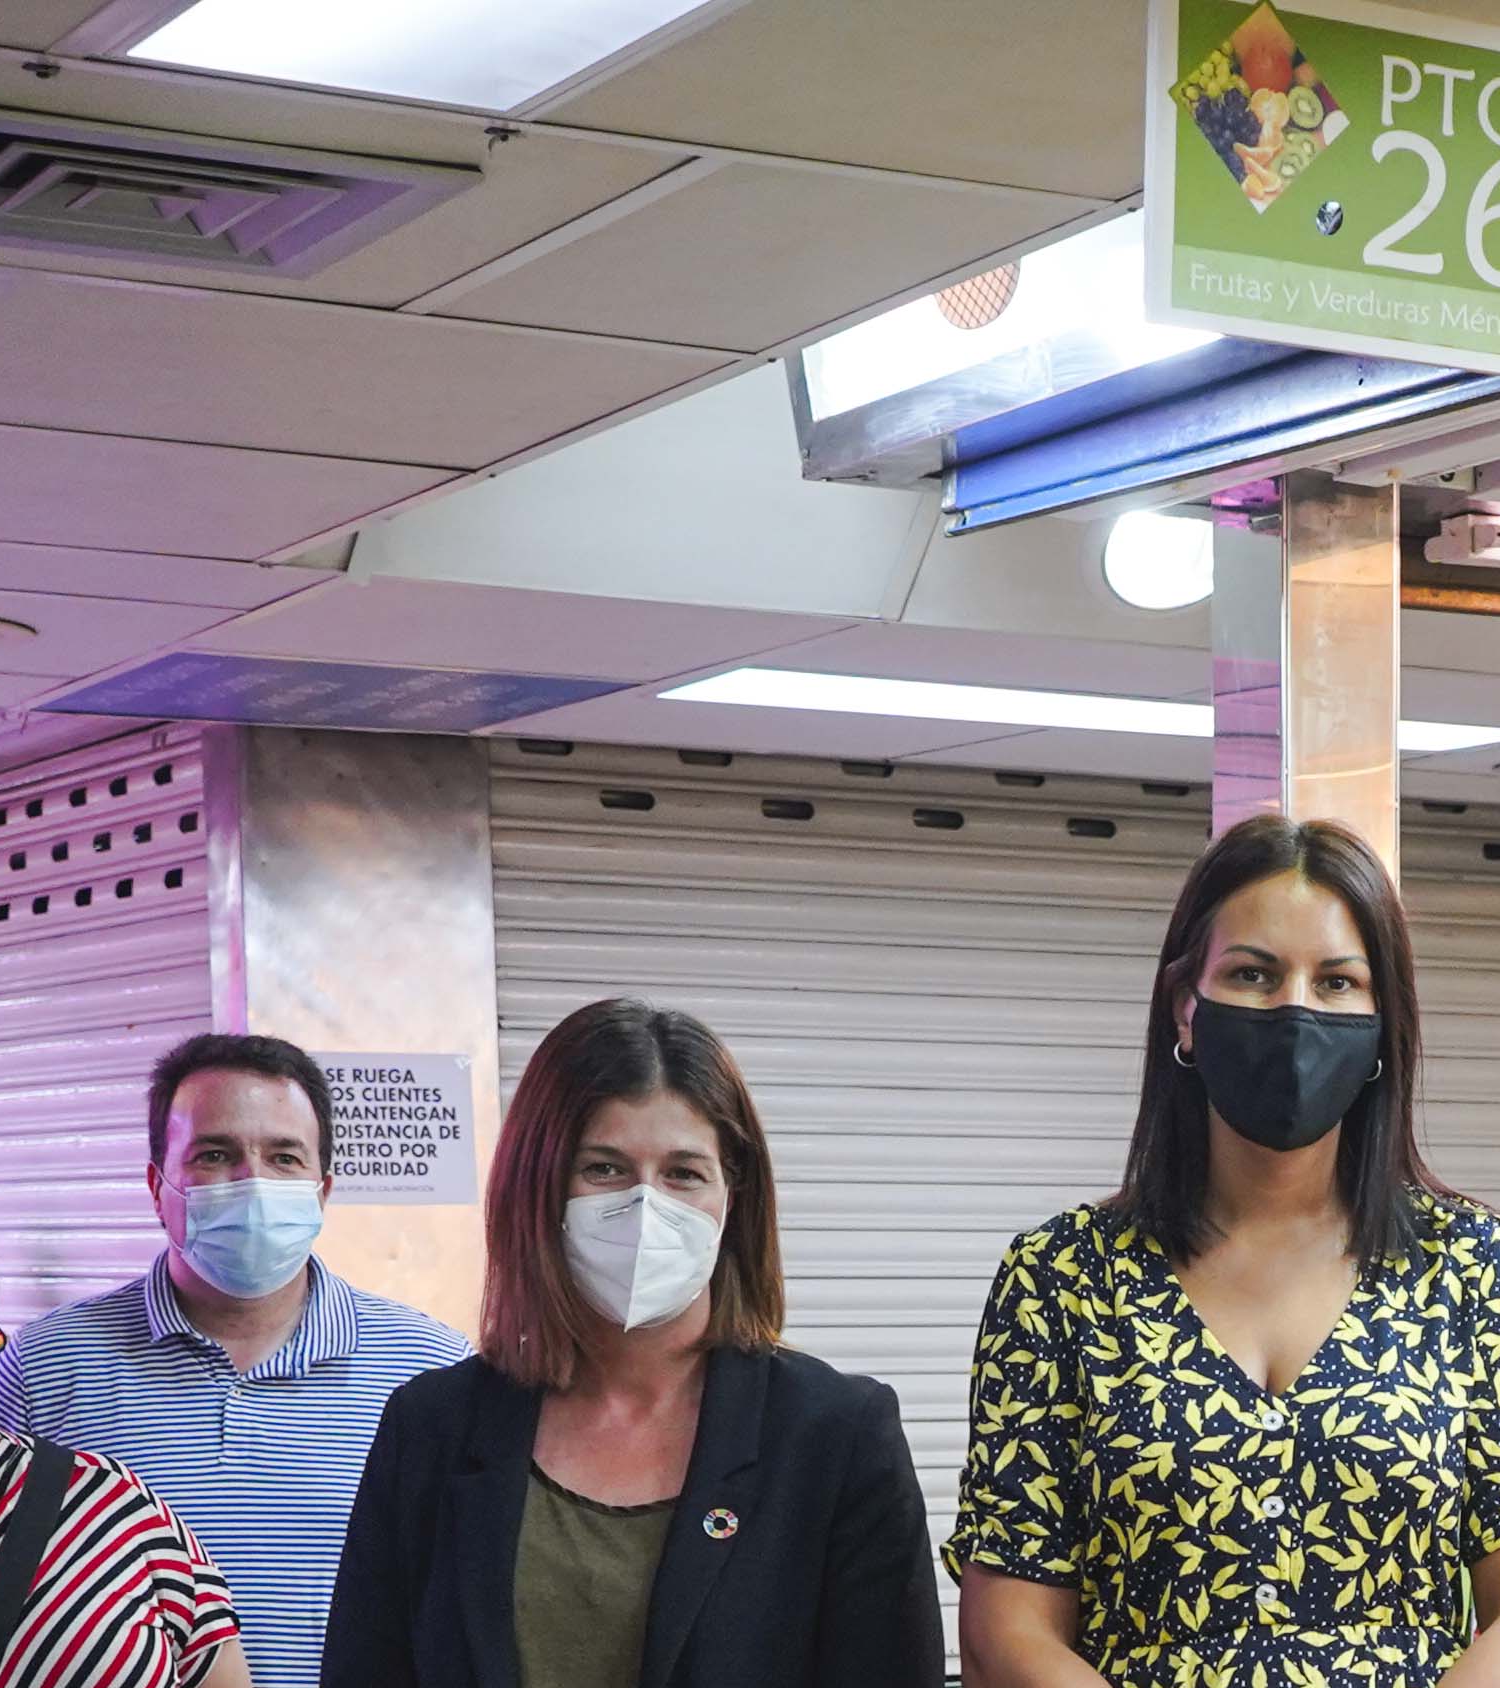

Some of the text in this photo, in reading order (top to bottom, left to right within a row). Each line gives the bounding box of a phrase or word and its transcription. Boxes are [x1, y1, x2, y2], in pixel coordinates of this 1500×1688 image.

[1189, 263, 1274, 301] Frutas
[1282, 282, 1301, 312] y
[1309, 281, 1430, 324] Verduras
[325, 1067, 416, 1084] SE RUEGA
[331, 1087, 443, 1103] OS CLIENTES
[332, 1105, 457, 1121] MANTENGAN
[334, 1124, 461, 1140] DISTANCIA DE
[331, 1142, 438, 1159] METRO POR
[333, 1161, 430, 1177] EGURIDAD
